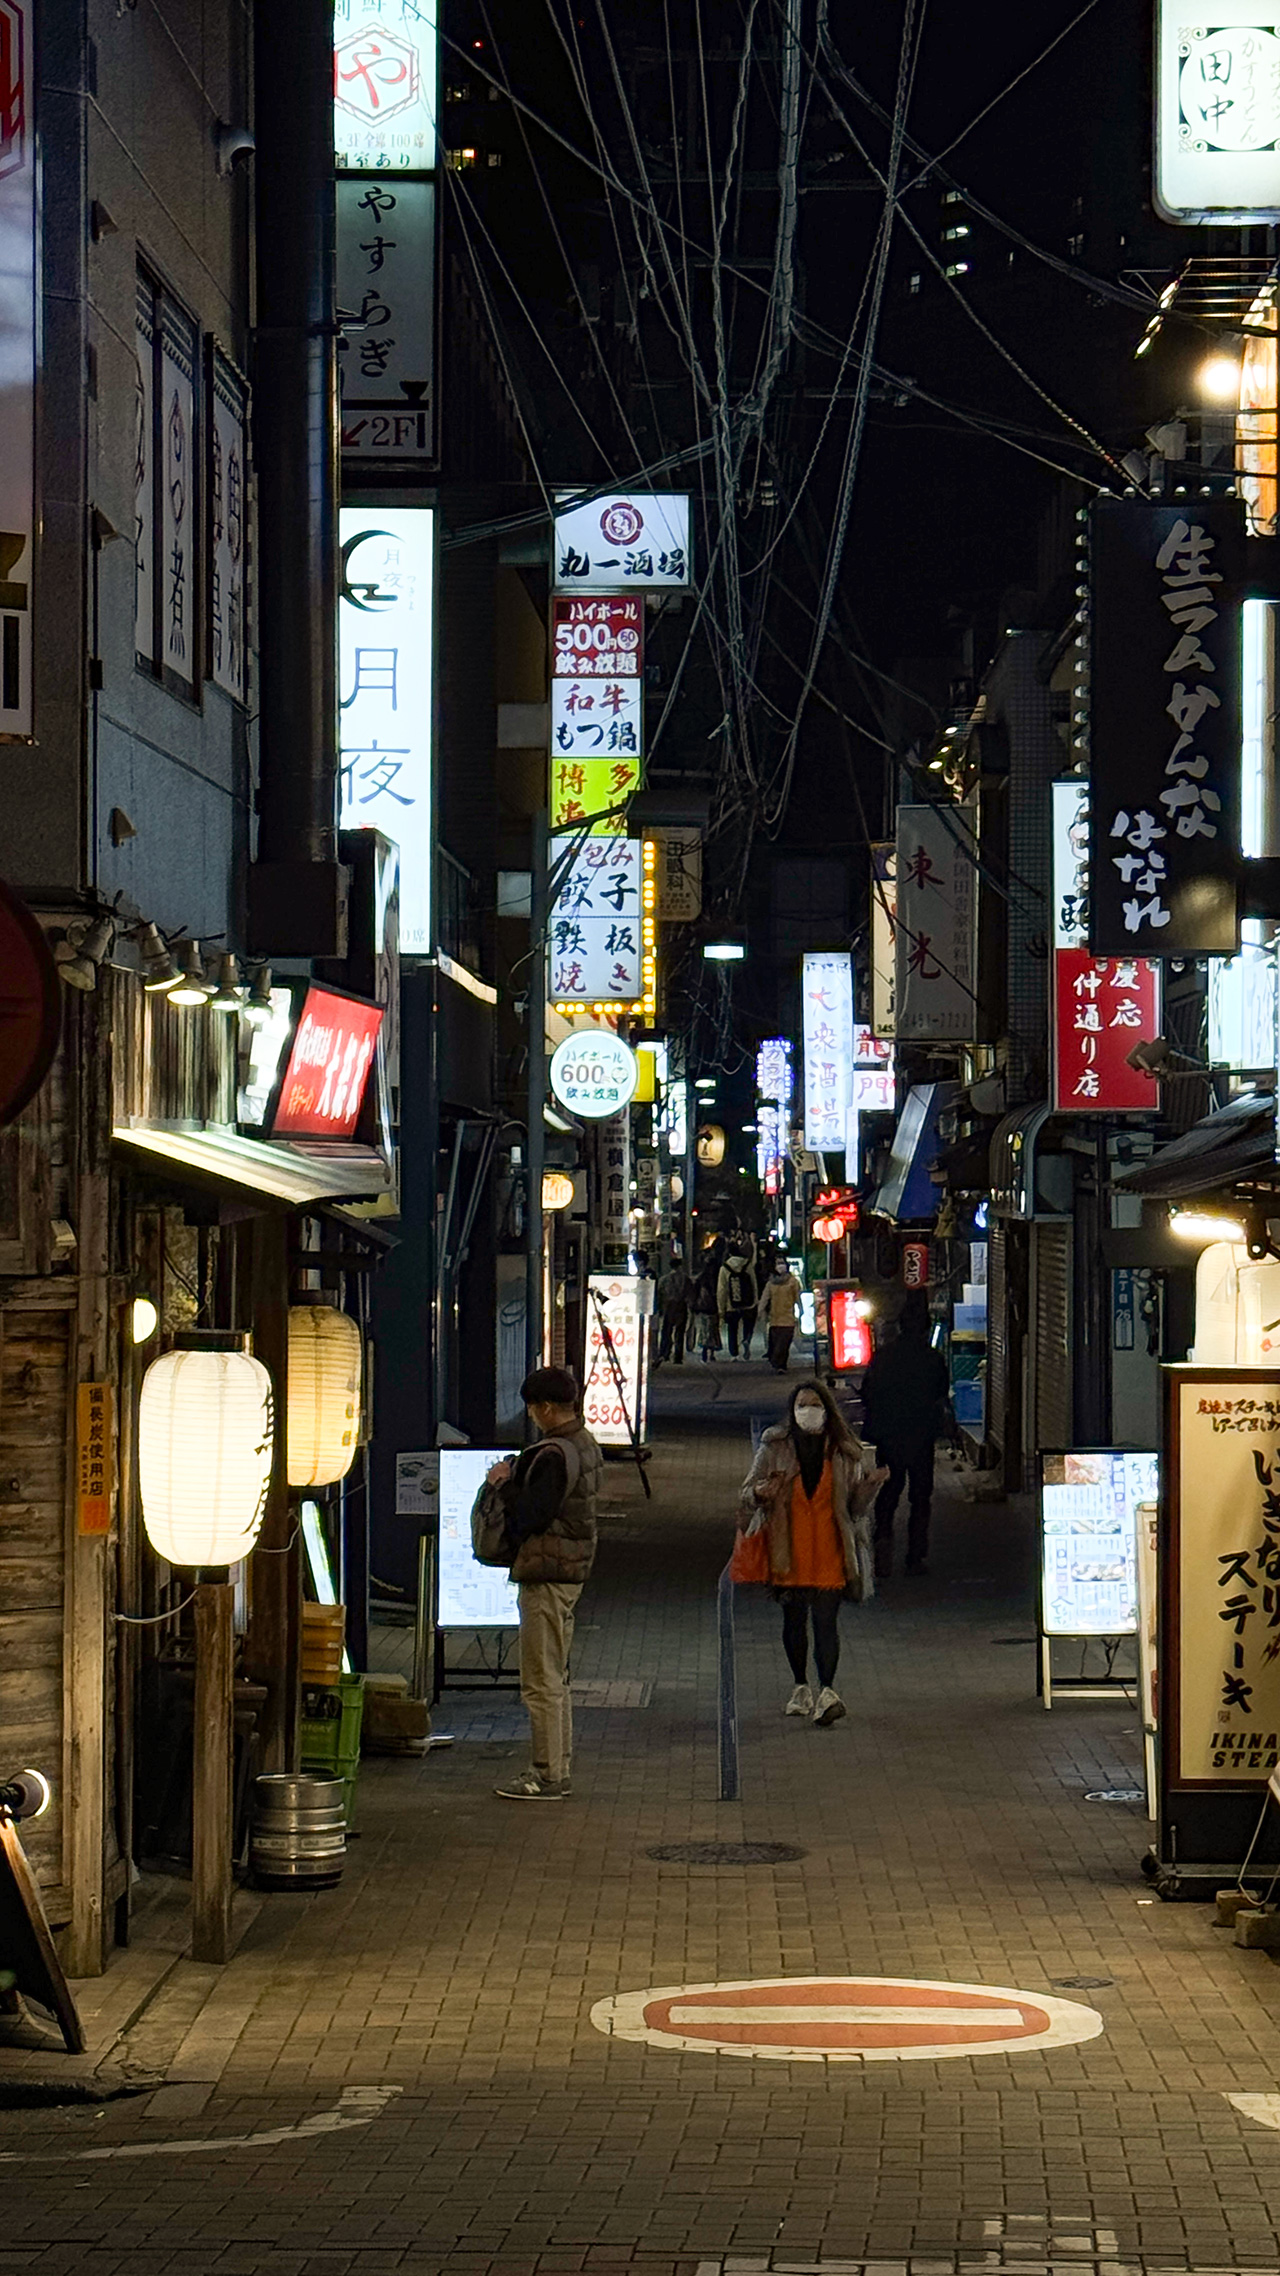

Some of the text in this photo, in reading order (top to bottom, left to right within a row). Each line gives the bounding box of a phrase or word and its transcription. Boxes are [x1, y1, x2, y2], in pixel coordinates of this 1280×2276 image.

[340, 43, 406, 108] や
[1198, 49, 1234, 133] 田中
[358, 186, 397, 377] やすらぎ
[559, 546, 686, 580] 丸一酒場
[569, 602, 638, 621] ハイボール
[555, 652, 638, 674] 飲み放題
[1156, 519, 1224, 839] 生ラムかんな
[341, 647, 416, 805] 月夜
[565, 684, 630, 716] 和牛
[556, 721, 637, 752] もつ鍋
[556, 763, 636, 795] 博多
[559, 872, 637, 912] 餃子
[1109, 810, 1170, 933] はなれ
[556, 921, 636, 956] 鉄板
[903, 845, 944, 979] 東光
[555, 961, 632, 994] 焼き
[1110, 959, 1142, 1027] 慶応
[1073, 972, 1104, 1098] 仲通り店
[88, 1387, 104, 1496] 備長炭使用店
[1217, 1550, 1258, 1714] ステーキ
